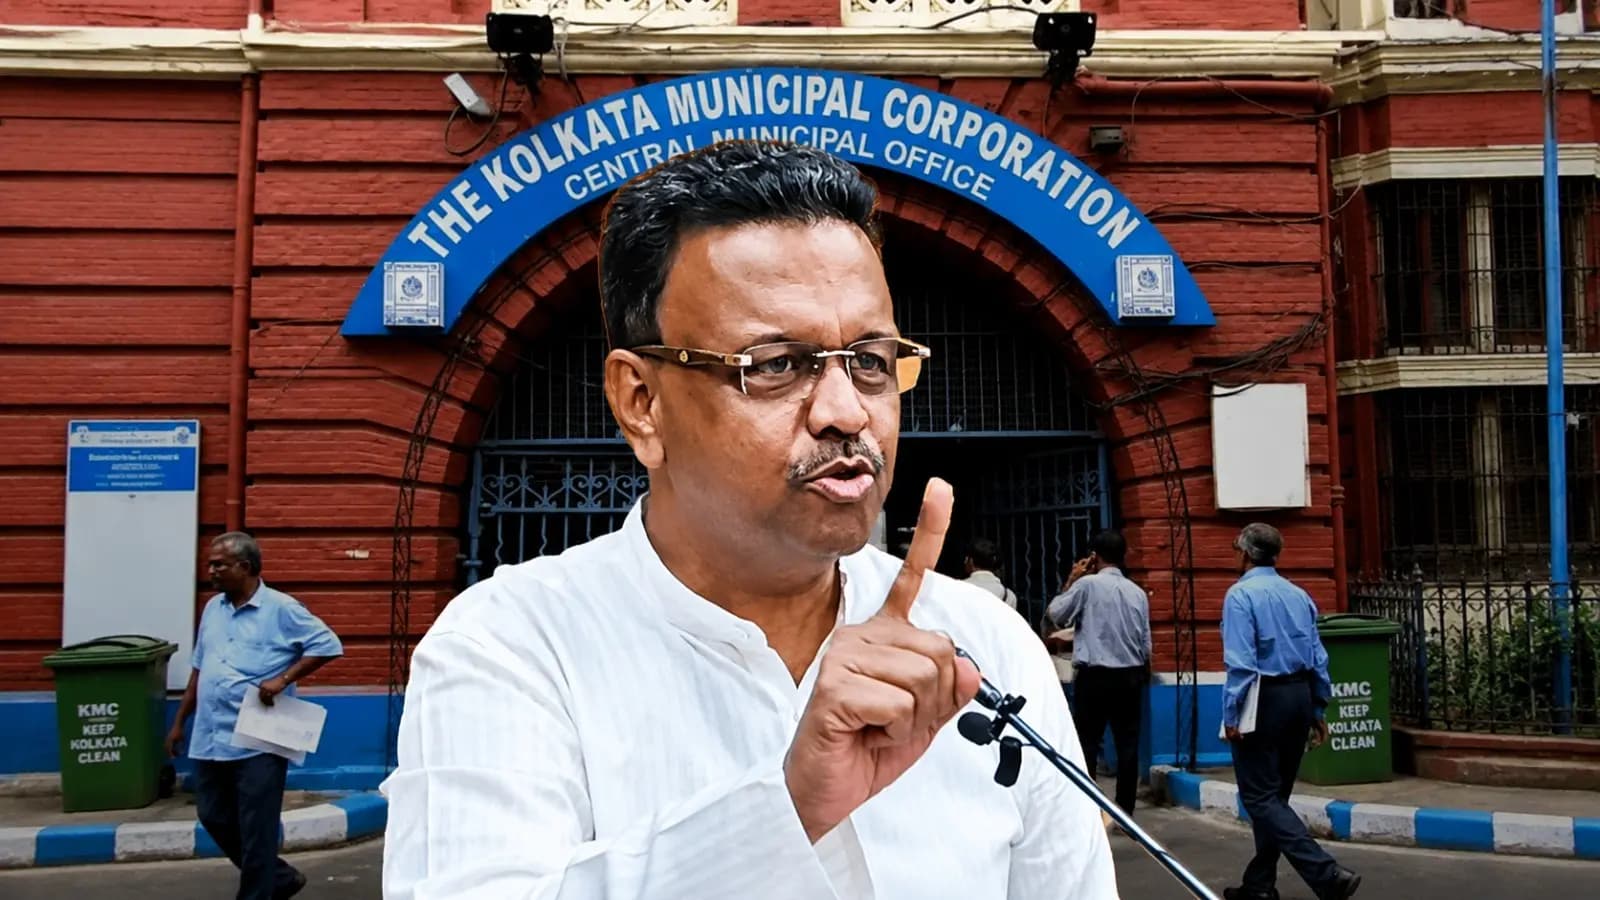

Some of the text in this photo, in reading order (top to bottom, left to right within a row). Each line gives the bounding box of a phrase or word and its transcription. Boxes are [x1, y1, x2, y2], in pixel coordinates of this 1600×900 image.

[407, 74, 1140, 258] THE KOLKATA MUNICIPAL CORPORATION
[884, 140, 995, 201] OFFICE
[1330, 681, 1371, 697] KMC
[77, 703, 119, 717] KMC
[1339, 704, 1369, 718] KEEP
[82, 723, 115, 735] KEEP
[1327, 719, 1382, 734] KOLKATA
[70, 736, 128, 750] KOLKATA
[1331, 736, 1376, 751] CLEAN
[78, 750, 121, 763] CLEAN
